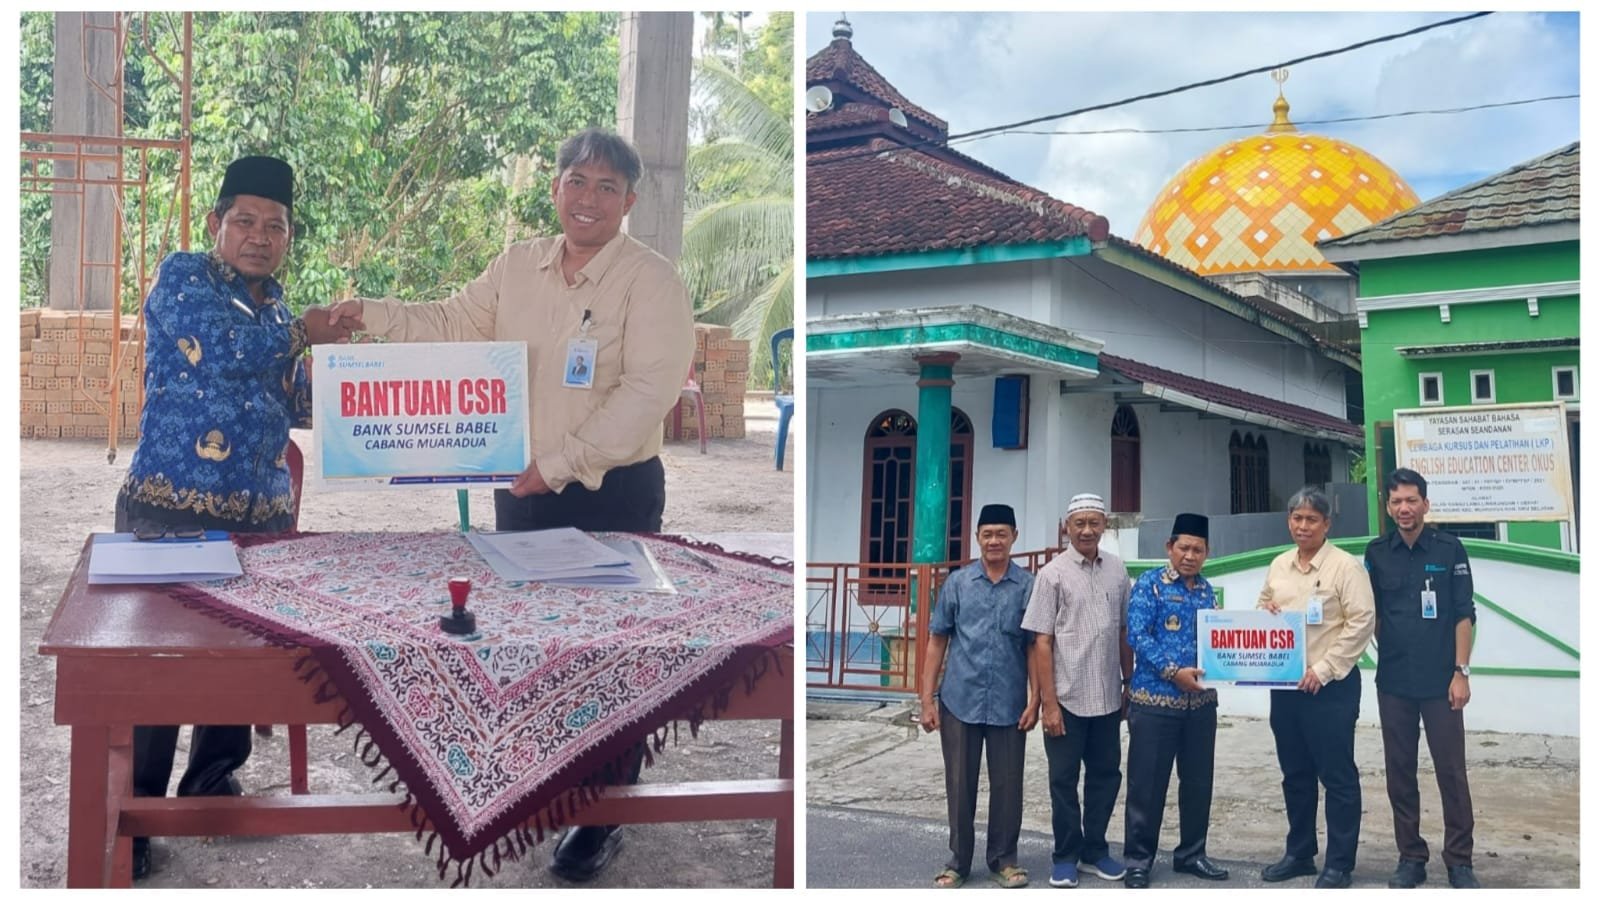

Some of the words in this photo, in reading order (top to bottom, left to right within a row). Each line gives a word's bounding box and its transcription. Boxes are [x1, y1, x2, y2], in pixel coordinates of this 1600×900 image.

[340, 379, 452, 417] BANTUAN
[457, 378, 507, 415] CSR
[1459, 414, 1489, 423] SAHABAT
[1491, 413, 1520, 422] BAHASA
[352, 423, 392, 437] BANK
[395, 422, 451, 435] SUMSEL
[455, 421, 499, 434] BABEL
[1438, 427, 1469, 435] SERASAN
[1470, 425, 1512, 434] SEANDANAN
[364, 438, 414, 450] CABANG
[416, 437, 487, 449] MUARADUA
[1444, 441, 1473, 451] KURSUS
[1474, 440, 1489, 450] DAN
[1490, 439, 1529, 449] PELATIHAN
[1535, 438, 1549, 448] LKP
[1410, 457, 1445, 474] ENGLISH
[1447, 455, 1495, 474] EDUCATION
[1497, 454, 1529, 473] CENTER
[1531, 453, 1554, 472] OKUS
[1211, 629, 1267, 649] BANTUAN
[1270, 629, 1295, 649] CSR
[1217, 652, 1237, 660] BANK
[1238, 652, 1267, 660] SUMSEL
[1268, 652, 1290, 660] BABEL
